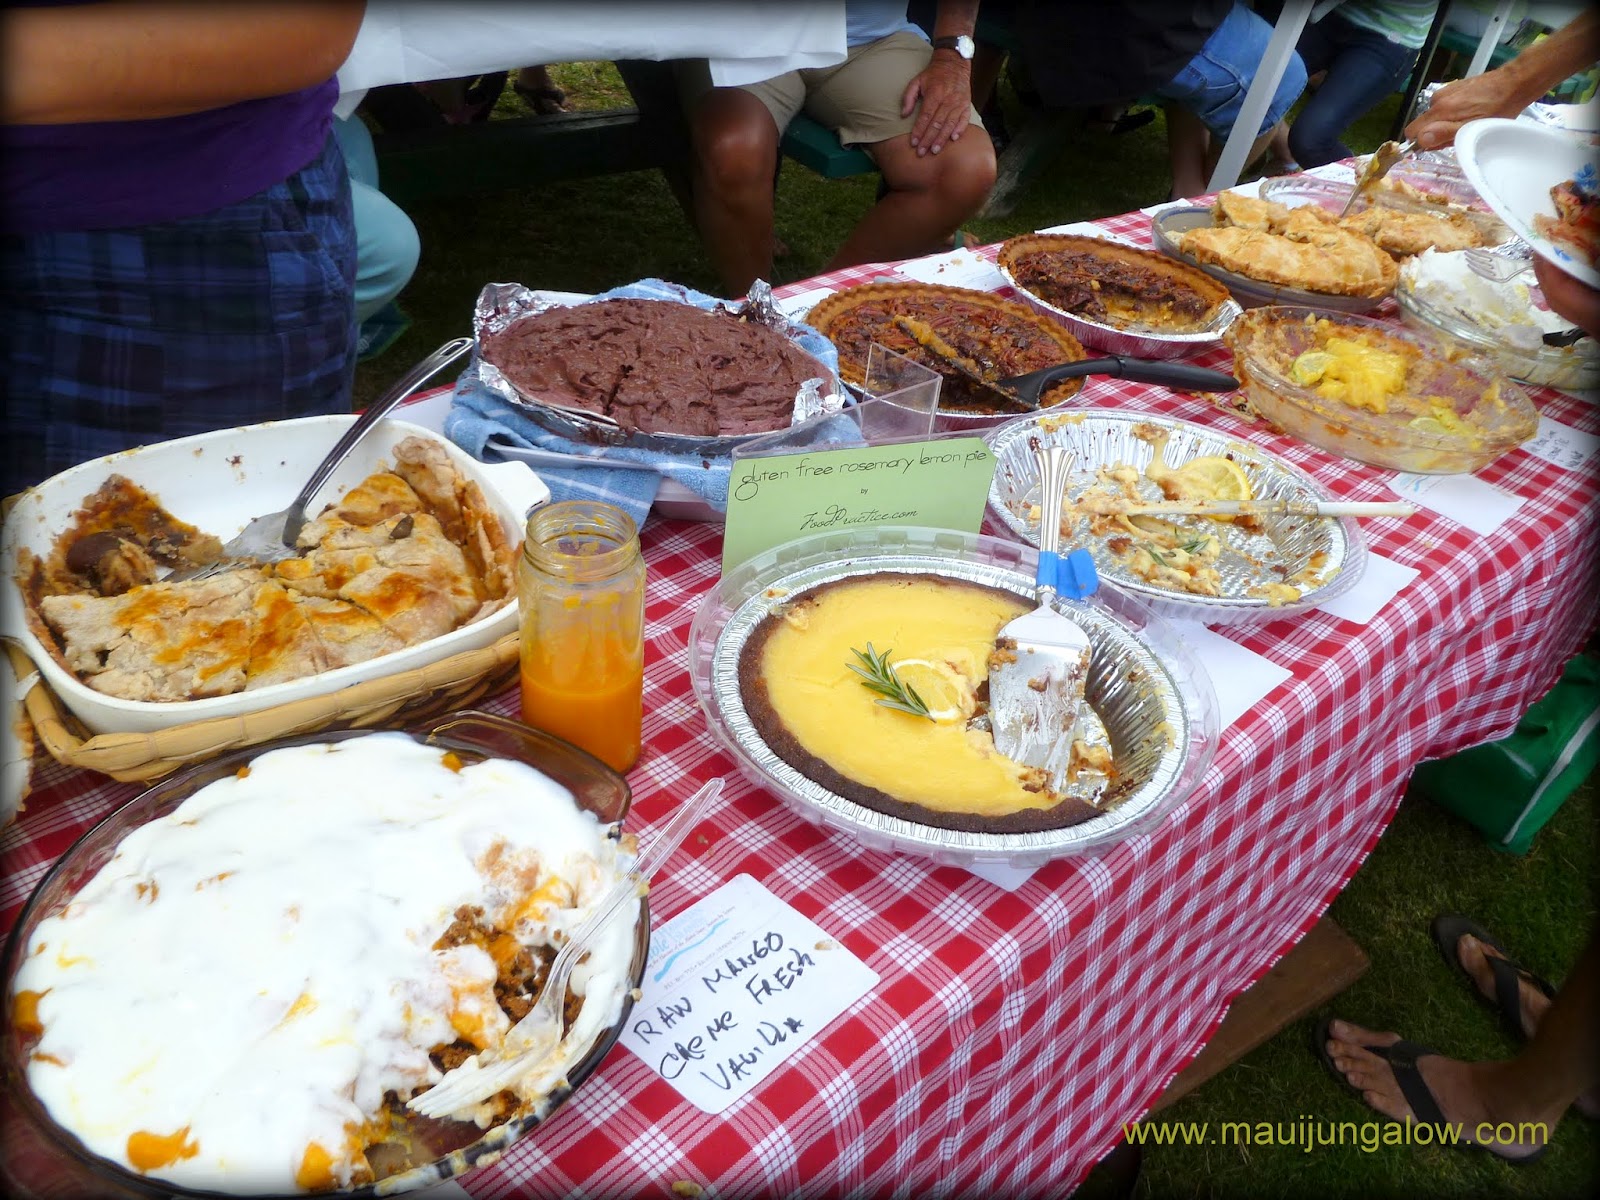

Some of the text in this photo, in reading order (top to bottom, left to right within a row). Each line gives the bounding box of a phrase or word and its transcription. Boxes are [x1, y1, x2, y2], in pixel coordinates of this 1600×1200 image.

[735, 447, 987, 502] gluten free rosemary lemon pie
[800, 504, 918, 531] FoodPractice.com
[633, 997, 692, 1044] RAW
[702, 932, 784, 993] MANGO
